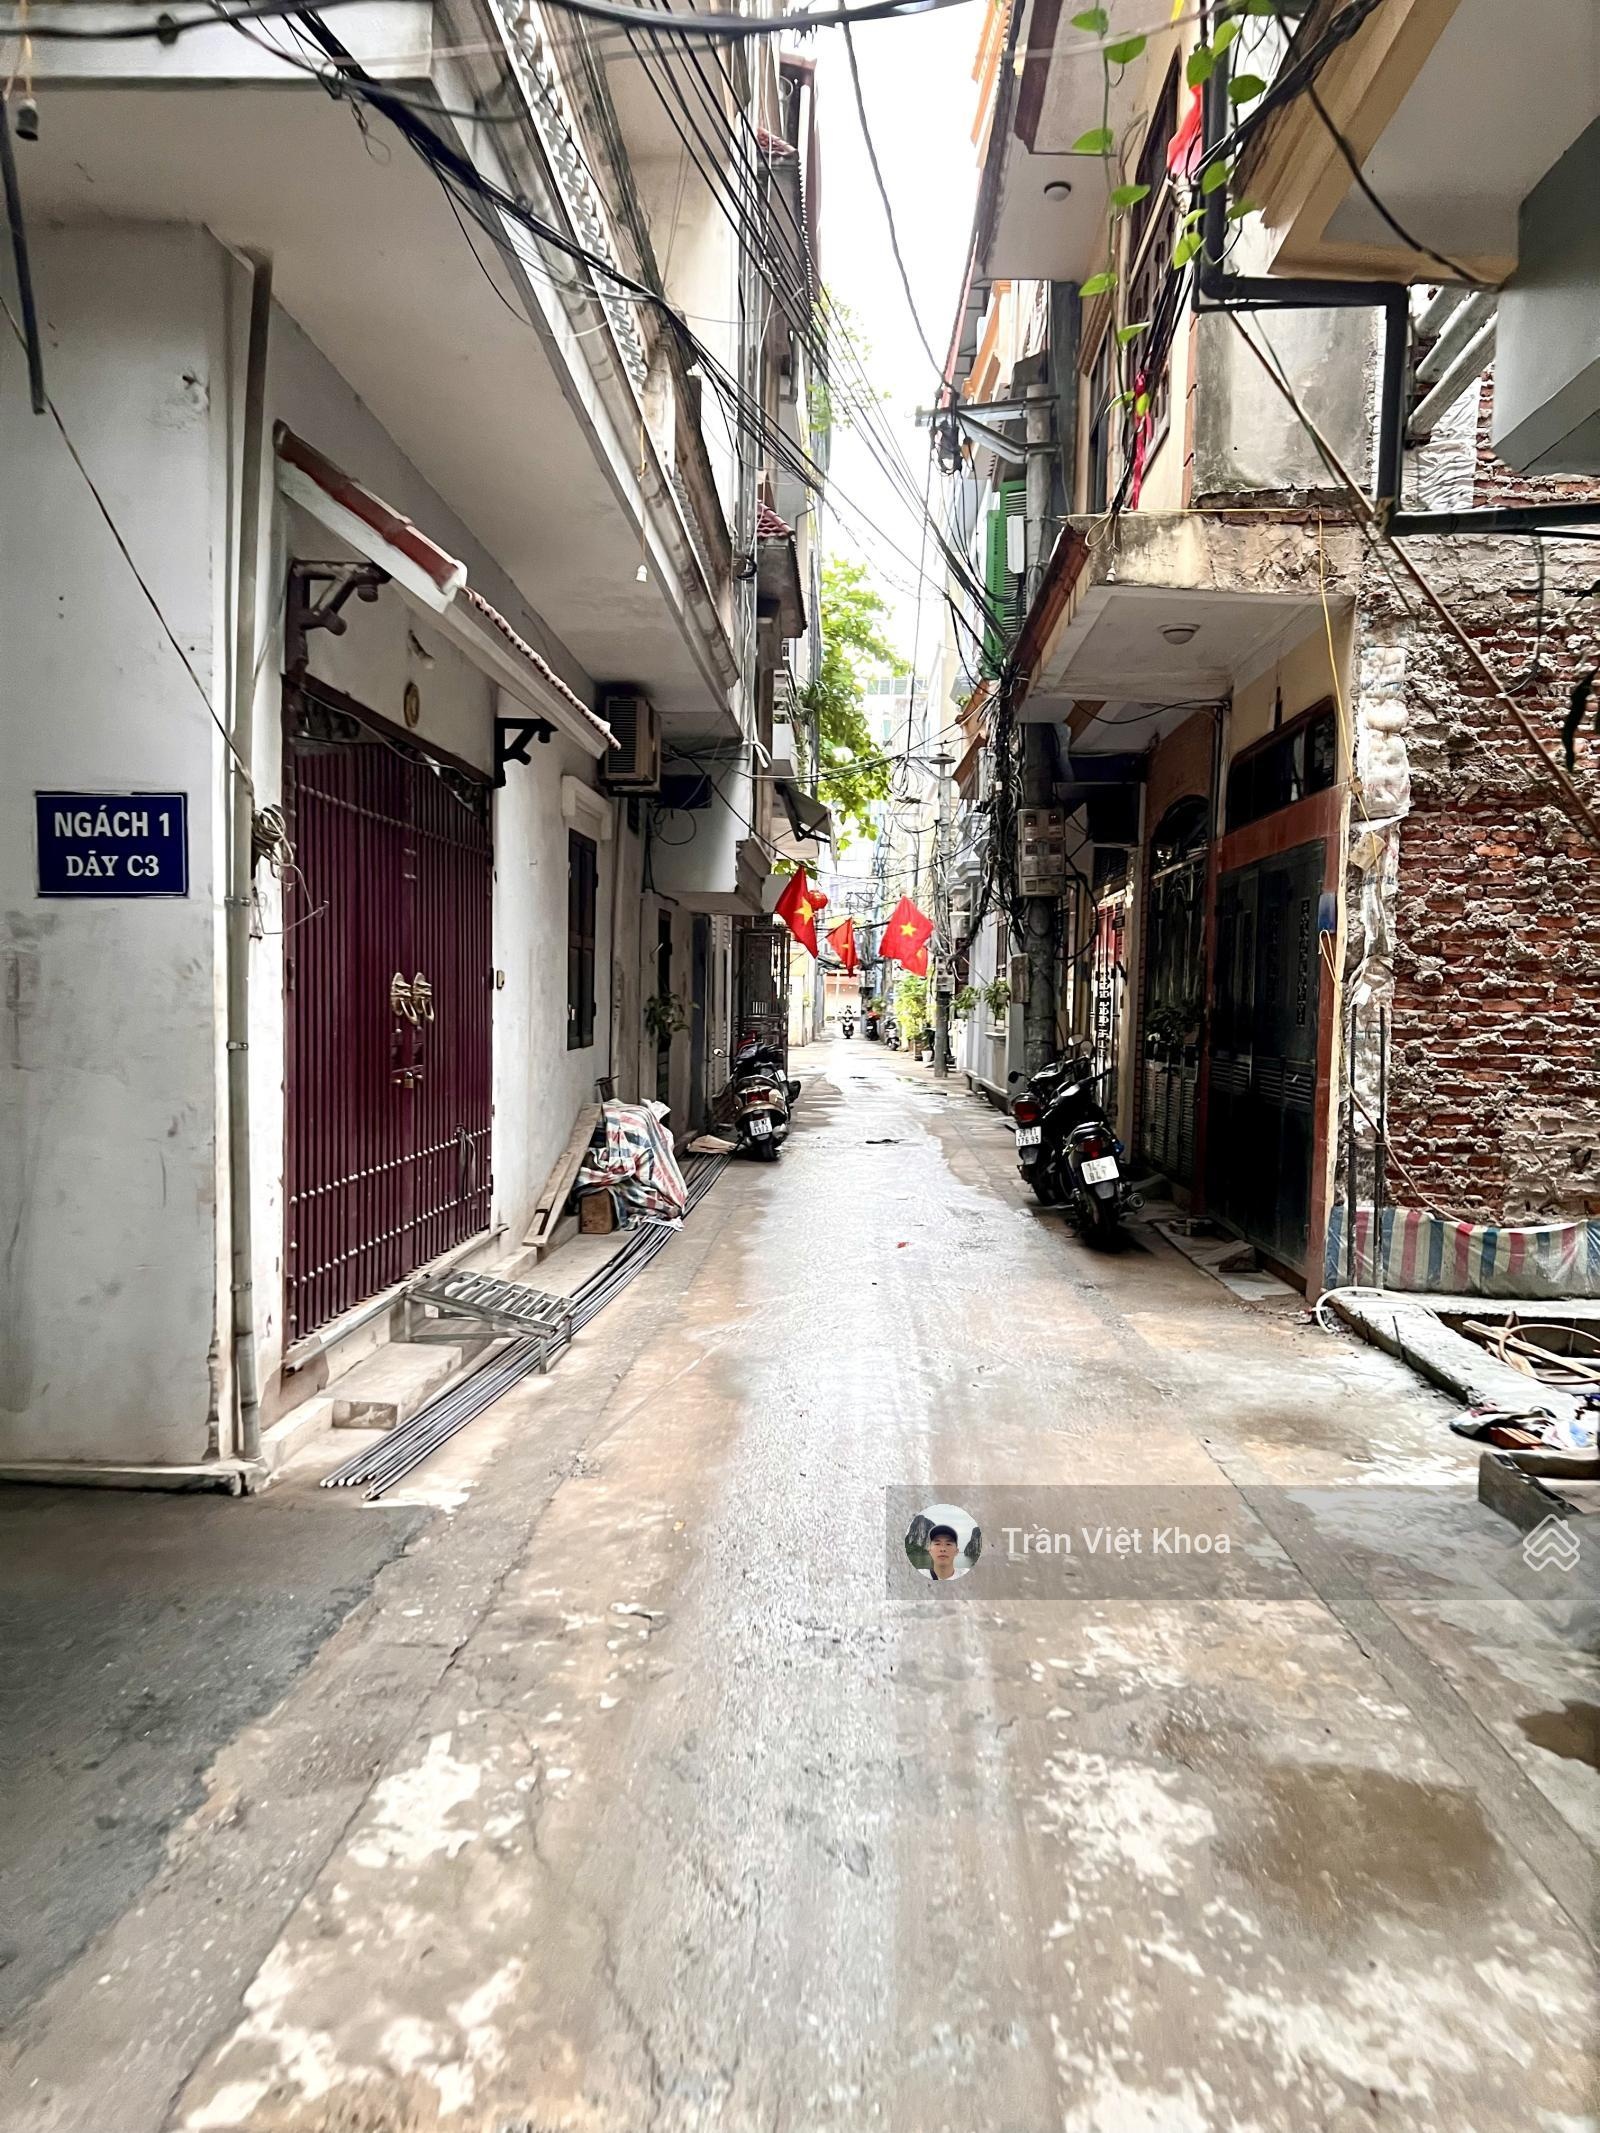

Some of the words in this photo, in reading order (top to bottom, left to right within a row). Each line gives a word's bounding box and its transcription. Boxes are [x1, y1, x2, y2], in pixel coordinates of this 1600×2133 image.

[54, 804, 149, 837] NGÁCH
[158, 812, 170, 837] 1
[66, 850, 119, 877] DÃY
[127, 855, 160, 877] C3
